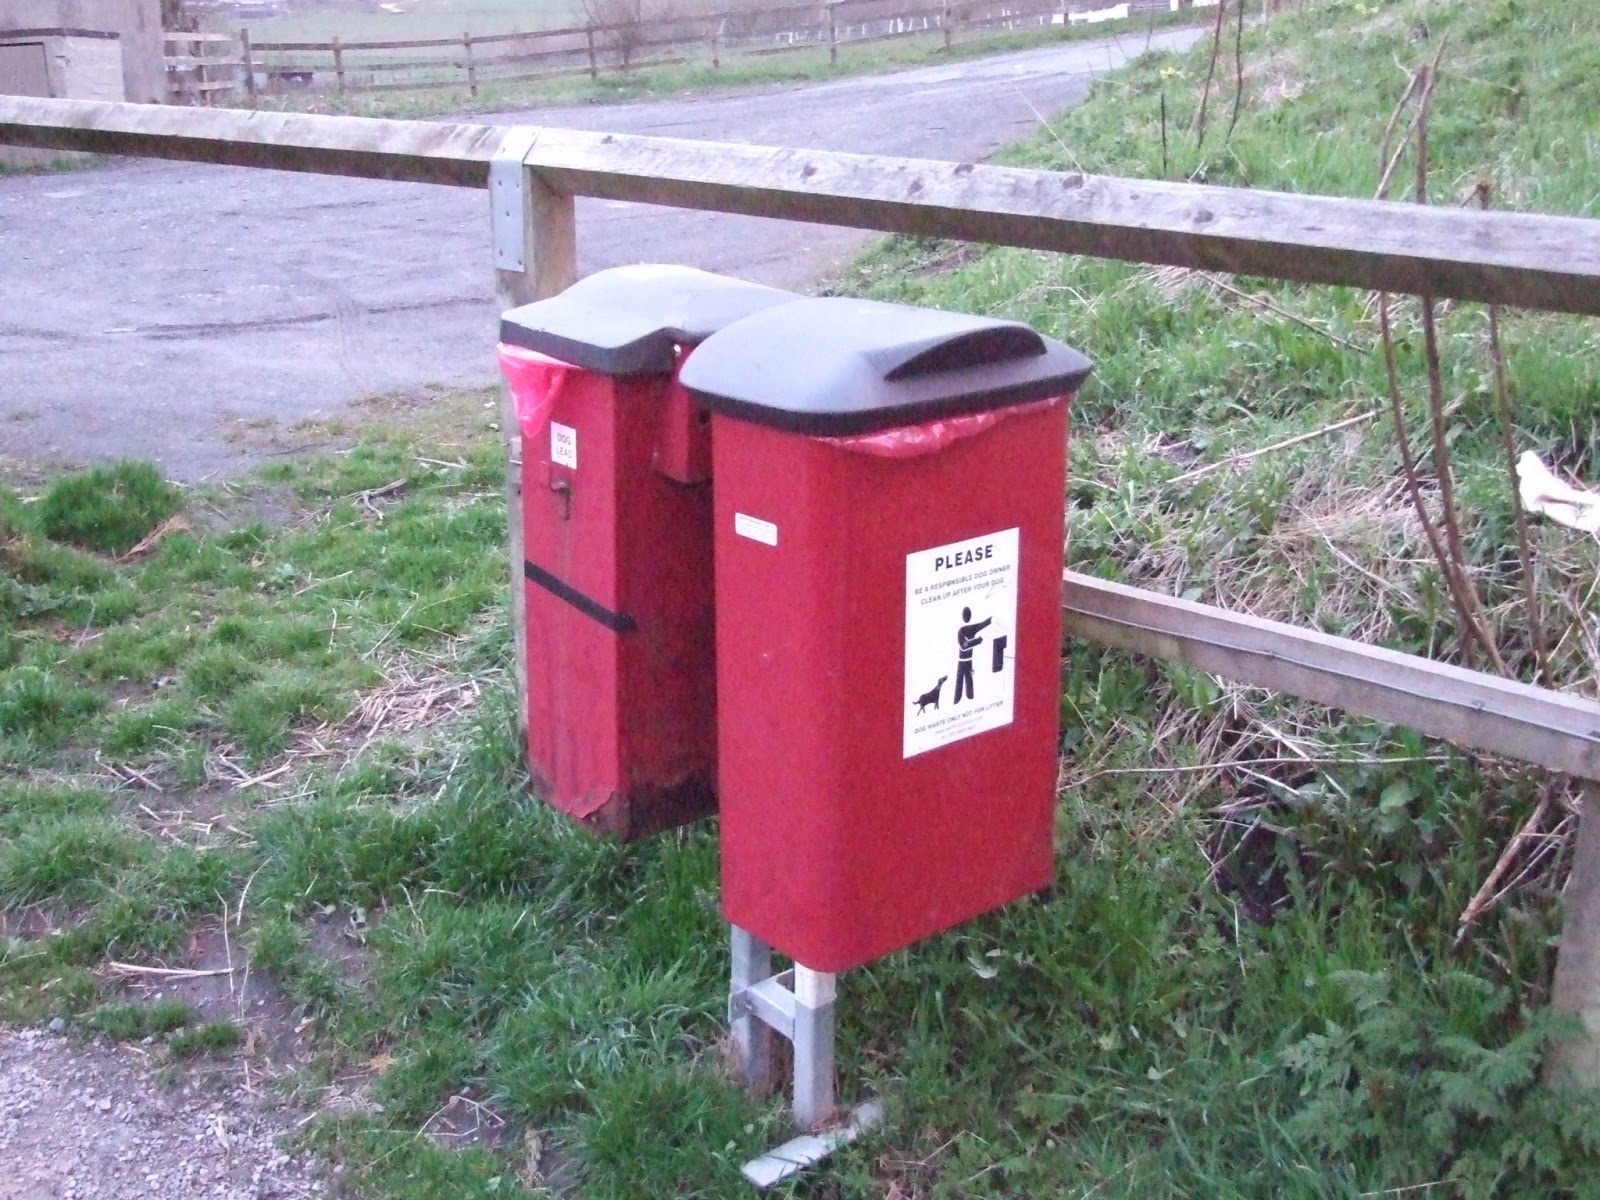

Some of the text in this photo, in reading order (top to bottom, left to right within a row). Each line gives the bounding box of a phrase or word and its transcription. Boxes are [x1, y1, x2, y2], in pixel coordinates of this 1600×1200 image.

[557, 432, 571, 445] DOG
[935, 544, 994, 572] PLEASE
[914, 587, 923, 596] BE
[930, 574, 972, 590] RESPONSIBLE
[974, 570, 987, 580] DOG
[988, 564, 1011, 576] OWNER
[920, 594, 942, 605] CLEAN
[952, 586, 972, 596] AFTER
[974, 581, 990, 591] YOUR
[990, 577, 1004, 586] DOG
[914, 725, 926, 734] DOG
[928, 718, 946, 729] WASTE
[947, 714, 960, 724] ONLY
[974, 706, 984, 714] FOR
[986, 700, 1004, 711] LITTER
